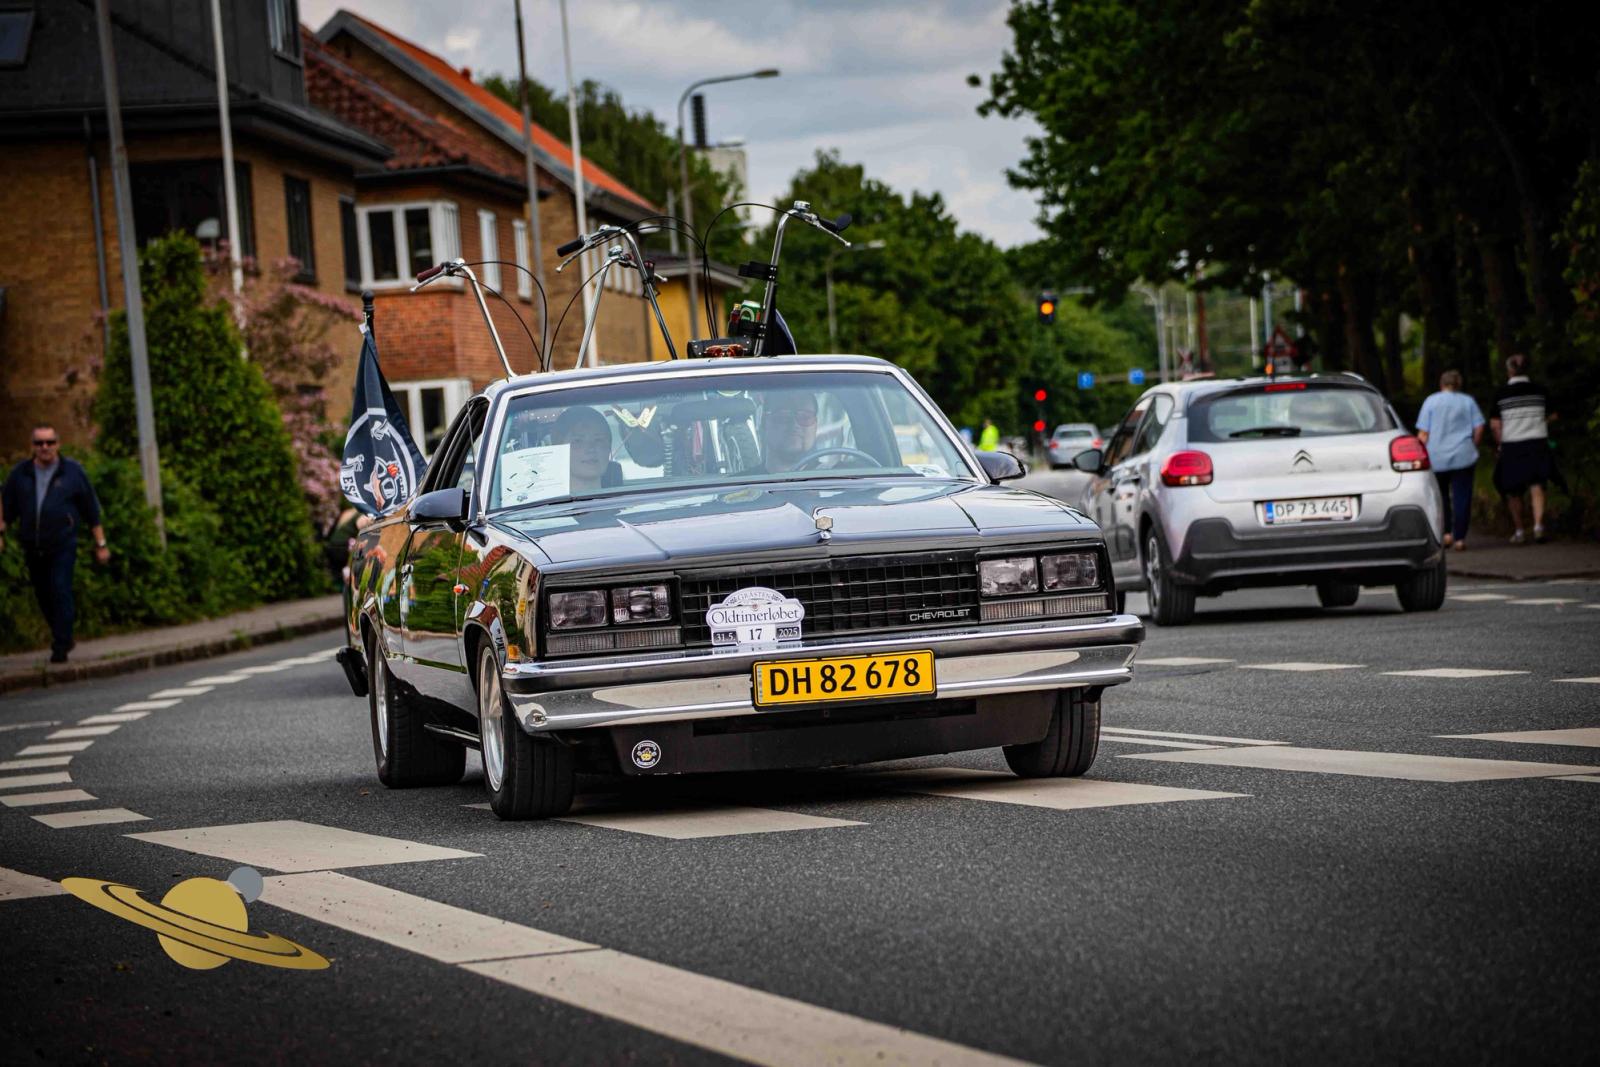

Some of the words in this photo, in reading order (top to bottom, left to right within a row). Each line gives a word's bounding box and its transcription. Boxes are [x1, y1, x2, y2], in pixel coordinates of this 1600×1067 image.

[1275, 503, 1295, 516] DP
[1298, 502, 1317, 514] 73
[1321, 500, 1348, 513] 445
[711, 606, 799, 624] Oldtimerløbet
[909, 608, 970, 621] CHEVROLET
[749, 628, 762, 640] 17
[778, 627, 798, 638] 2025
[769, 666, 812, 696] DH
[820, 664, 857, 693] 82
[865, 658, 920, 689] 678
